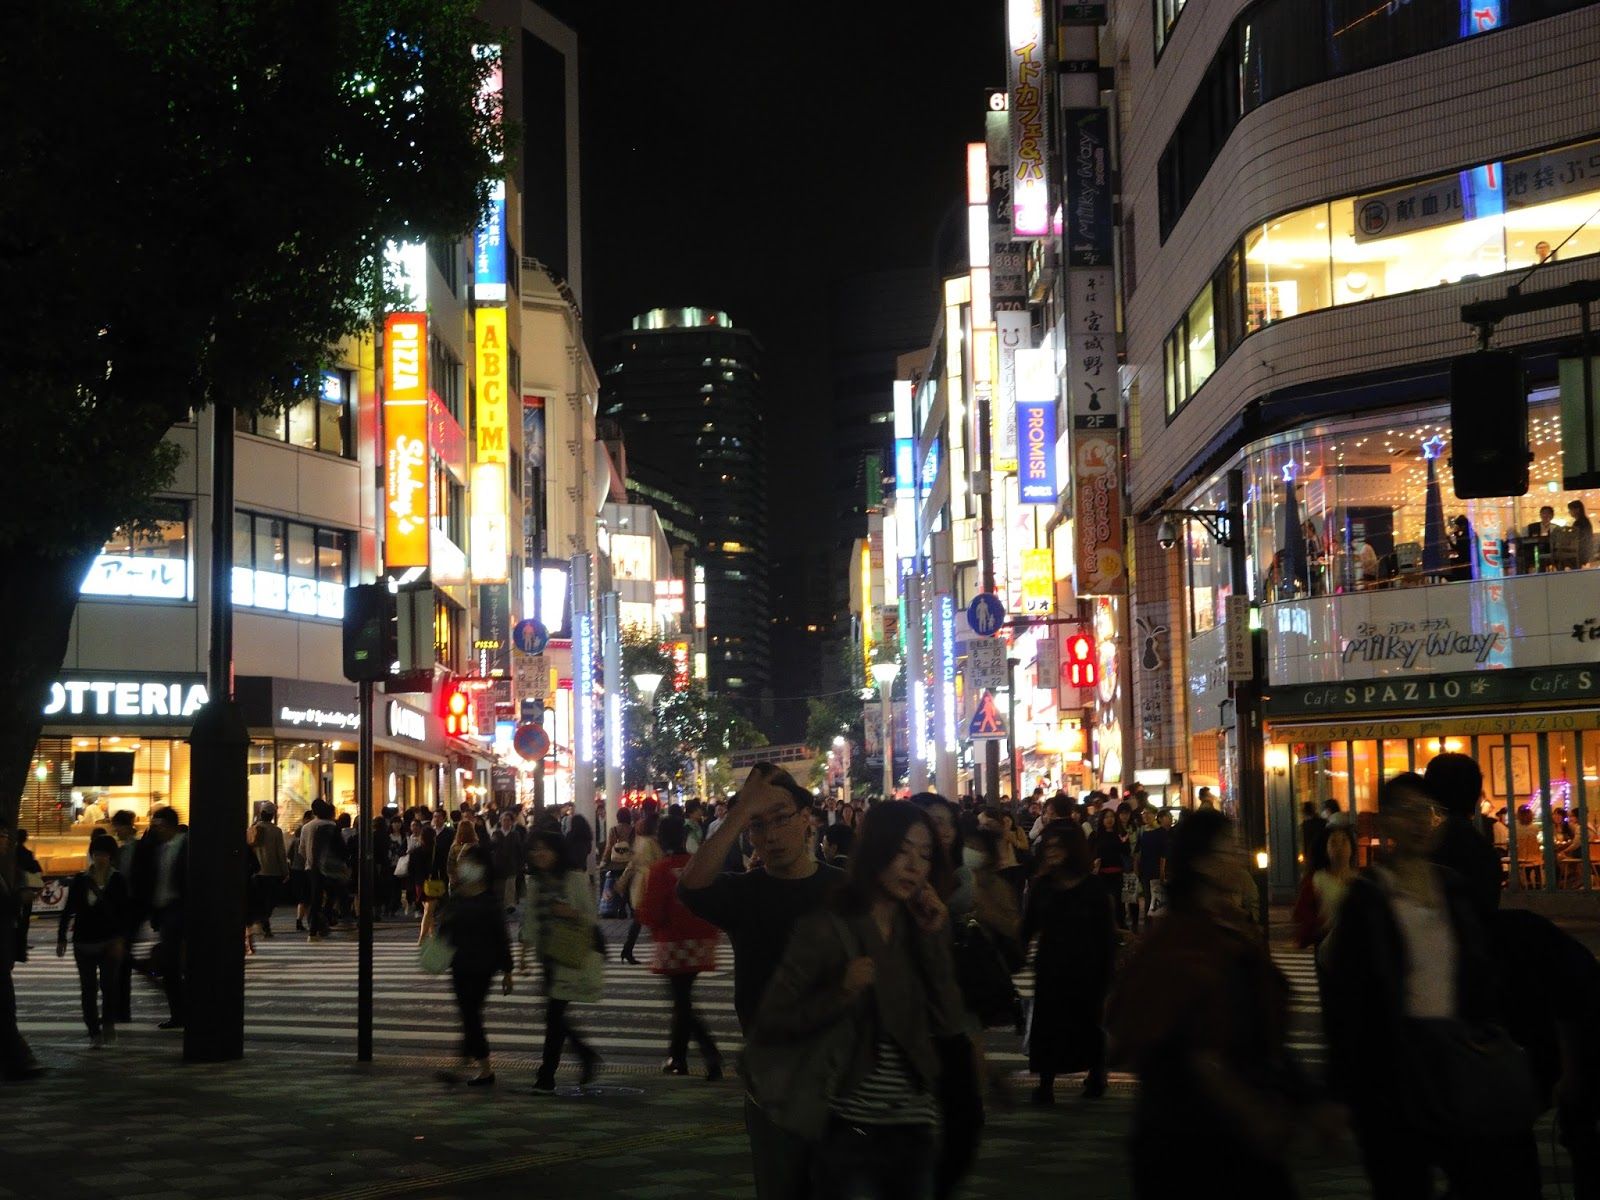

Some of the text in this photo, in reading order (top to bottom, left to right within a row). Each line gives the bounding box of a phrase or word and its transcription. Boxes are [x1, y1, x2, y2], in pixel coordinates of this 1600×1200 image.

[1013, 28, 1044, 188] イドカフェ&バー
[392, 323, 419, 391] PIZZA
[1083, 311, 1105, 376] 宮城野
[479, 324, 505, 462] ABC-M
[1086, 415, 1105, 428] 2F
[1028, 407, 1047, 479] PROMISE
[388, 434, 425, 535] Shakey's
[942, 597, 953, 618] CITY
[1343, 630, 1499, 669] Milky Way
[1344, 681, 1460, 704] SPAZIO
[1328, 724, 1401, 739] SPAZIO
[1494, 715, 1576, 731] SPAZIO
